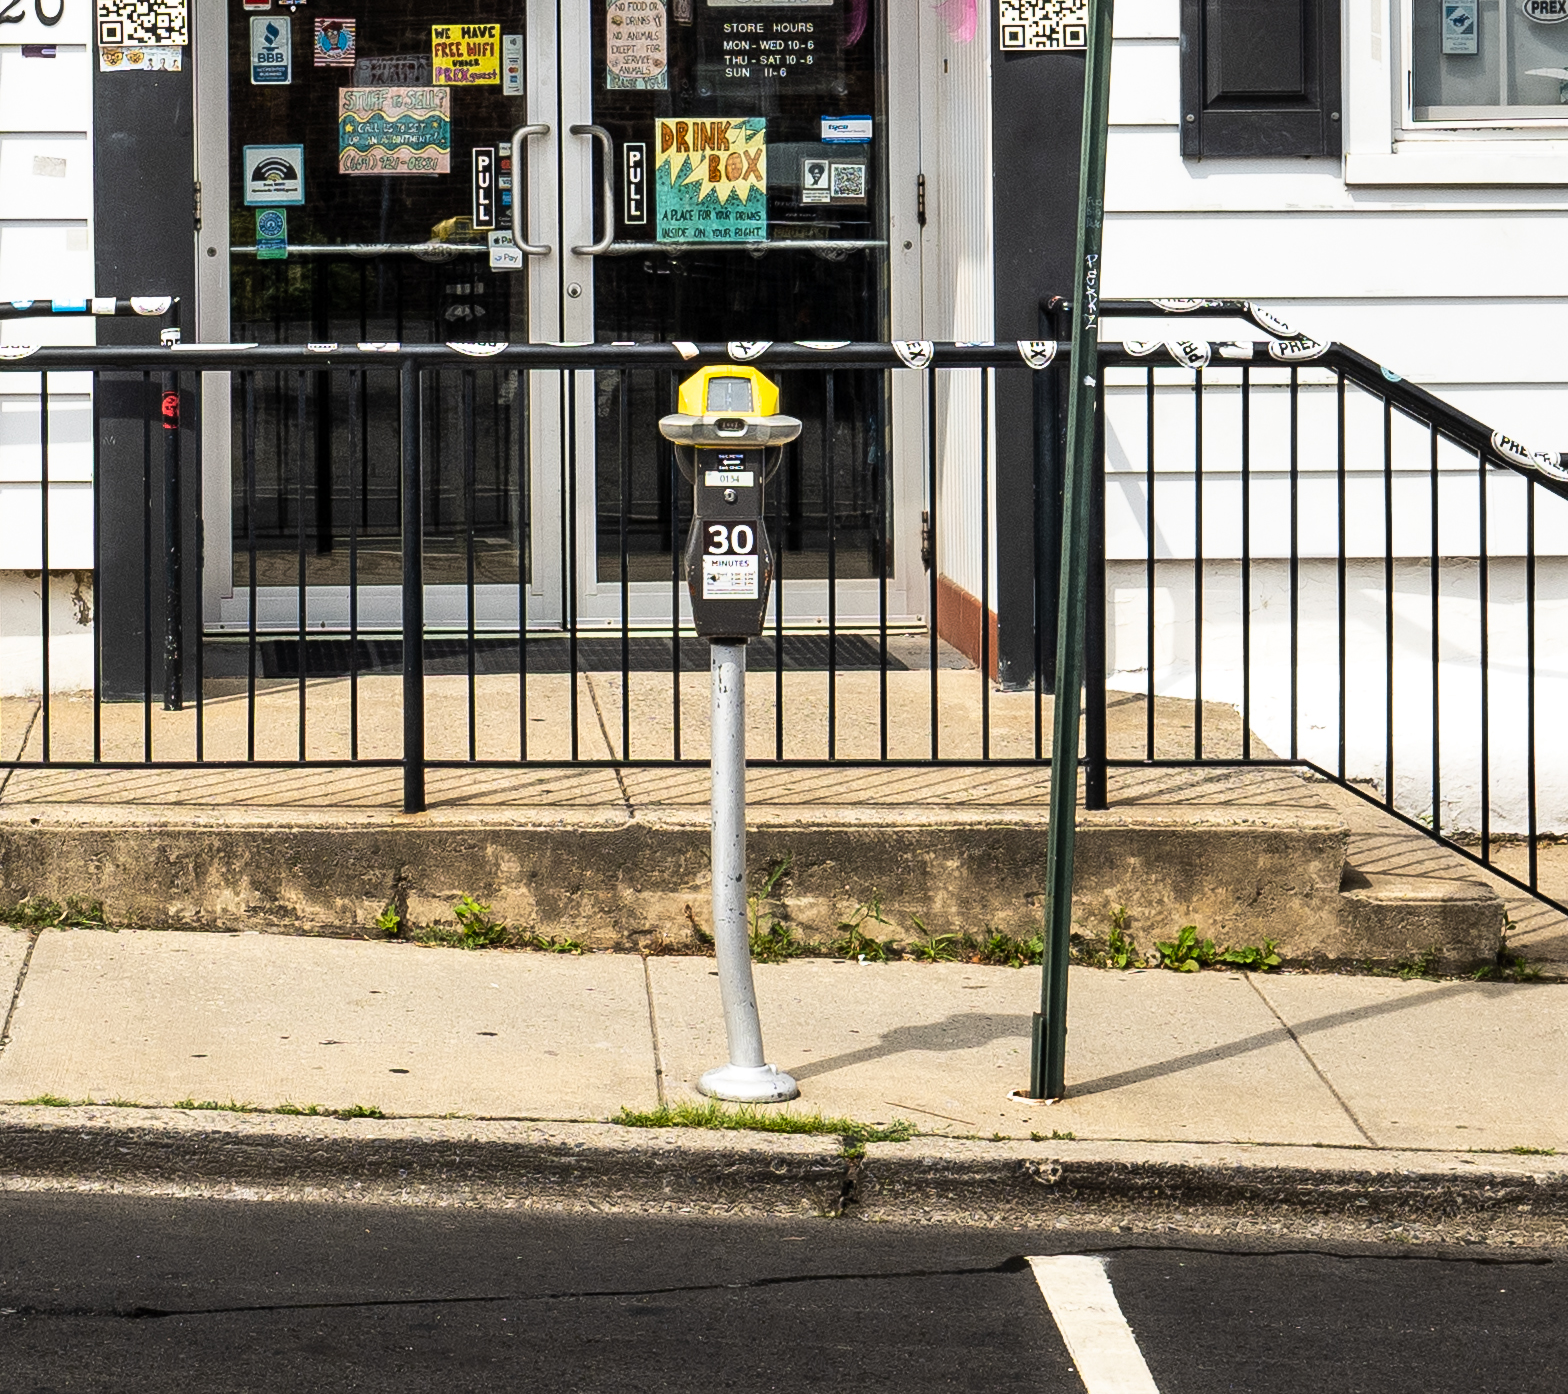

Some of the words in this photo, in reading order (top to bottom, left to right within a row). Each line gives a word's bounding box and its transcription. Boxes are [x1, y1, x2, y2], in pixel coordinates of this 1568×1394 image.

[614, 3, 624, 12] NO
[627, 2, 648, 12] FOOD
[1531, 0, 1567, 14] PREX
[625, 16, 651, 26] DRINKS
[433, 27, 451, 40] WE
[461, 25, 496, 39] HAVE
[723, 23, 764, 33] STORE
[773, 23, 814, 33] HOURS
[613, 32, 623, 40] NO
[626, 31, 660, 41] ANIMALS
[434, 42, 464, 58] FREE
[466, 41, 495, 57] WIFI
[611, 45, 637, 54] EXCEPT
[646, 44, 661, 53] FOR
[723, 40, 750, 50] MON
[759, 40, 784, 50] WED
[257, 52, 285, 64] BBB
[452, 58, 481, 67] UNDER
[622, 55, 651, 65] SERVICE
[724, 55, 748, 65] THU
[759, 55, 782, 65] SAT
[618, 66, 652, 75] ANIMALS
[725, 67, 750, 77] SUN
[343, 88, 389, 110] STUFF
[405, 88, 447, 109] SELL?
[357, 122, 380, 133] CALL
[383, 122, 394, 133] US
[408, 122, 426, 132] SET
[367, 135, 378, 145] AN
[661, 119, 731, 155] DRINK
[707, 148, 763, 183] BOX
[477, 155, 490, 221] PULL
[629, 151, 641, 216] PULL
[661, 209, 669, 221] A
[670, 209, 694, 222] PLACE
[697, 209, 710, 221] FOR
[734, 210, 762, 222] DRINKS
[662, 227, 689, 239] INSIDE
[693, 227, 706, 238] ON
[712, 227, 731, 239] YOUR
[734, 226, 762, 238] RIGHT
[504, 253, 519, 264] Pay
[708, 524, 754, 555] 30
[711, 559, 750, 567] MINUTES
